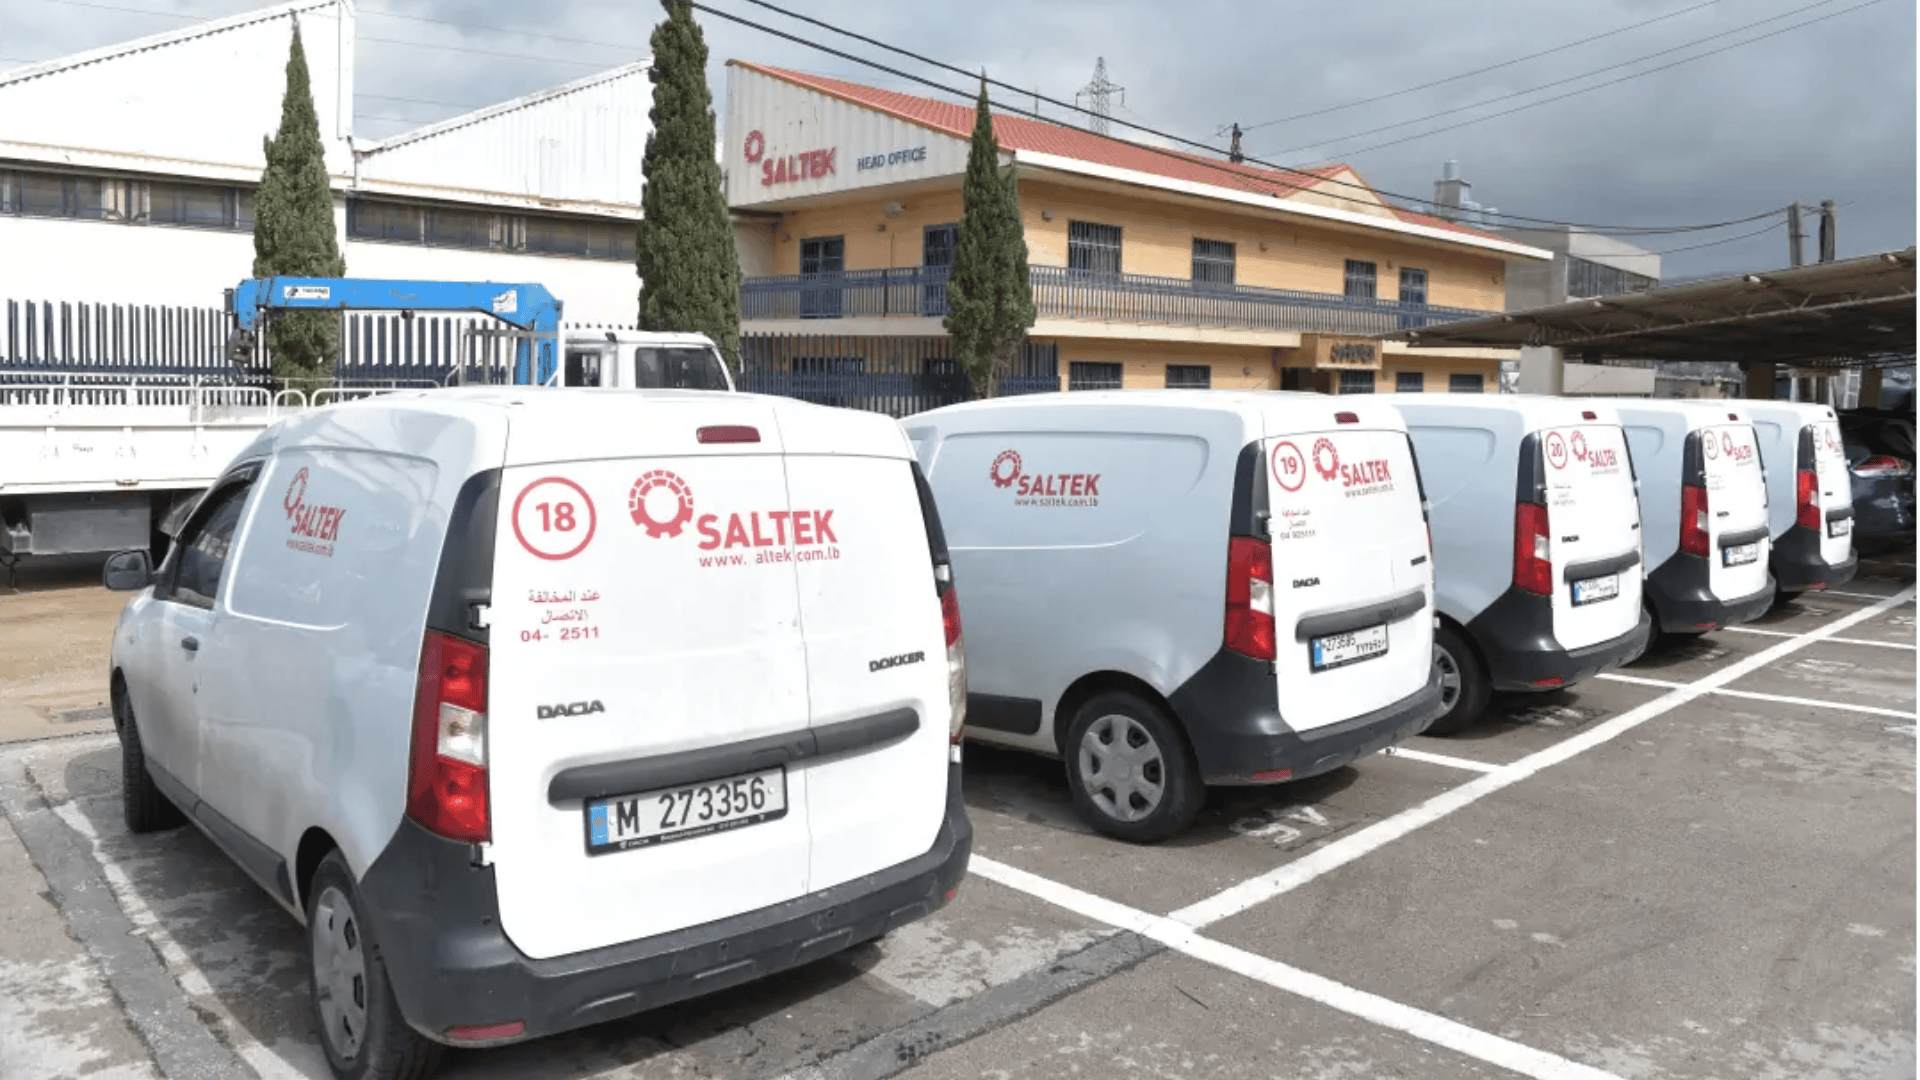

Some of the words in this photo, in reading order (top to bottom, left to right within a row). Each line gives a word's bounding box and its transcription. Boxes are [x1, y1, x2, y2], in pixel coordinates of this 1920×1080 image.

[761, 146, 836, 187] SALTEK
[857, 153, 885, 172] HEAD
[887, 147, 926, 166] OFFICE
[1550, 443, 1563, 457] 20
[1280, 456, 1298, 475] 19
[1340, 459, 1392, 487] SALTEK
[1016, 473, 1101, 496] SALTEK
[291, 504, 346, 541] SALTEK
[535, 502, 576, 532] 18
[697, 509, 838, 551] SALTEK
[580, 588, 600, 601] عند
[1292, 577, 1320, 588] DACIA
[868, 650, 925, 672] DOKKER
[537, 699, 605, 720] DACIA
[616, 798, 640, 836] M
[658, 776, 766, 830] 273356
